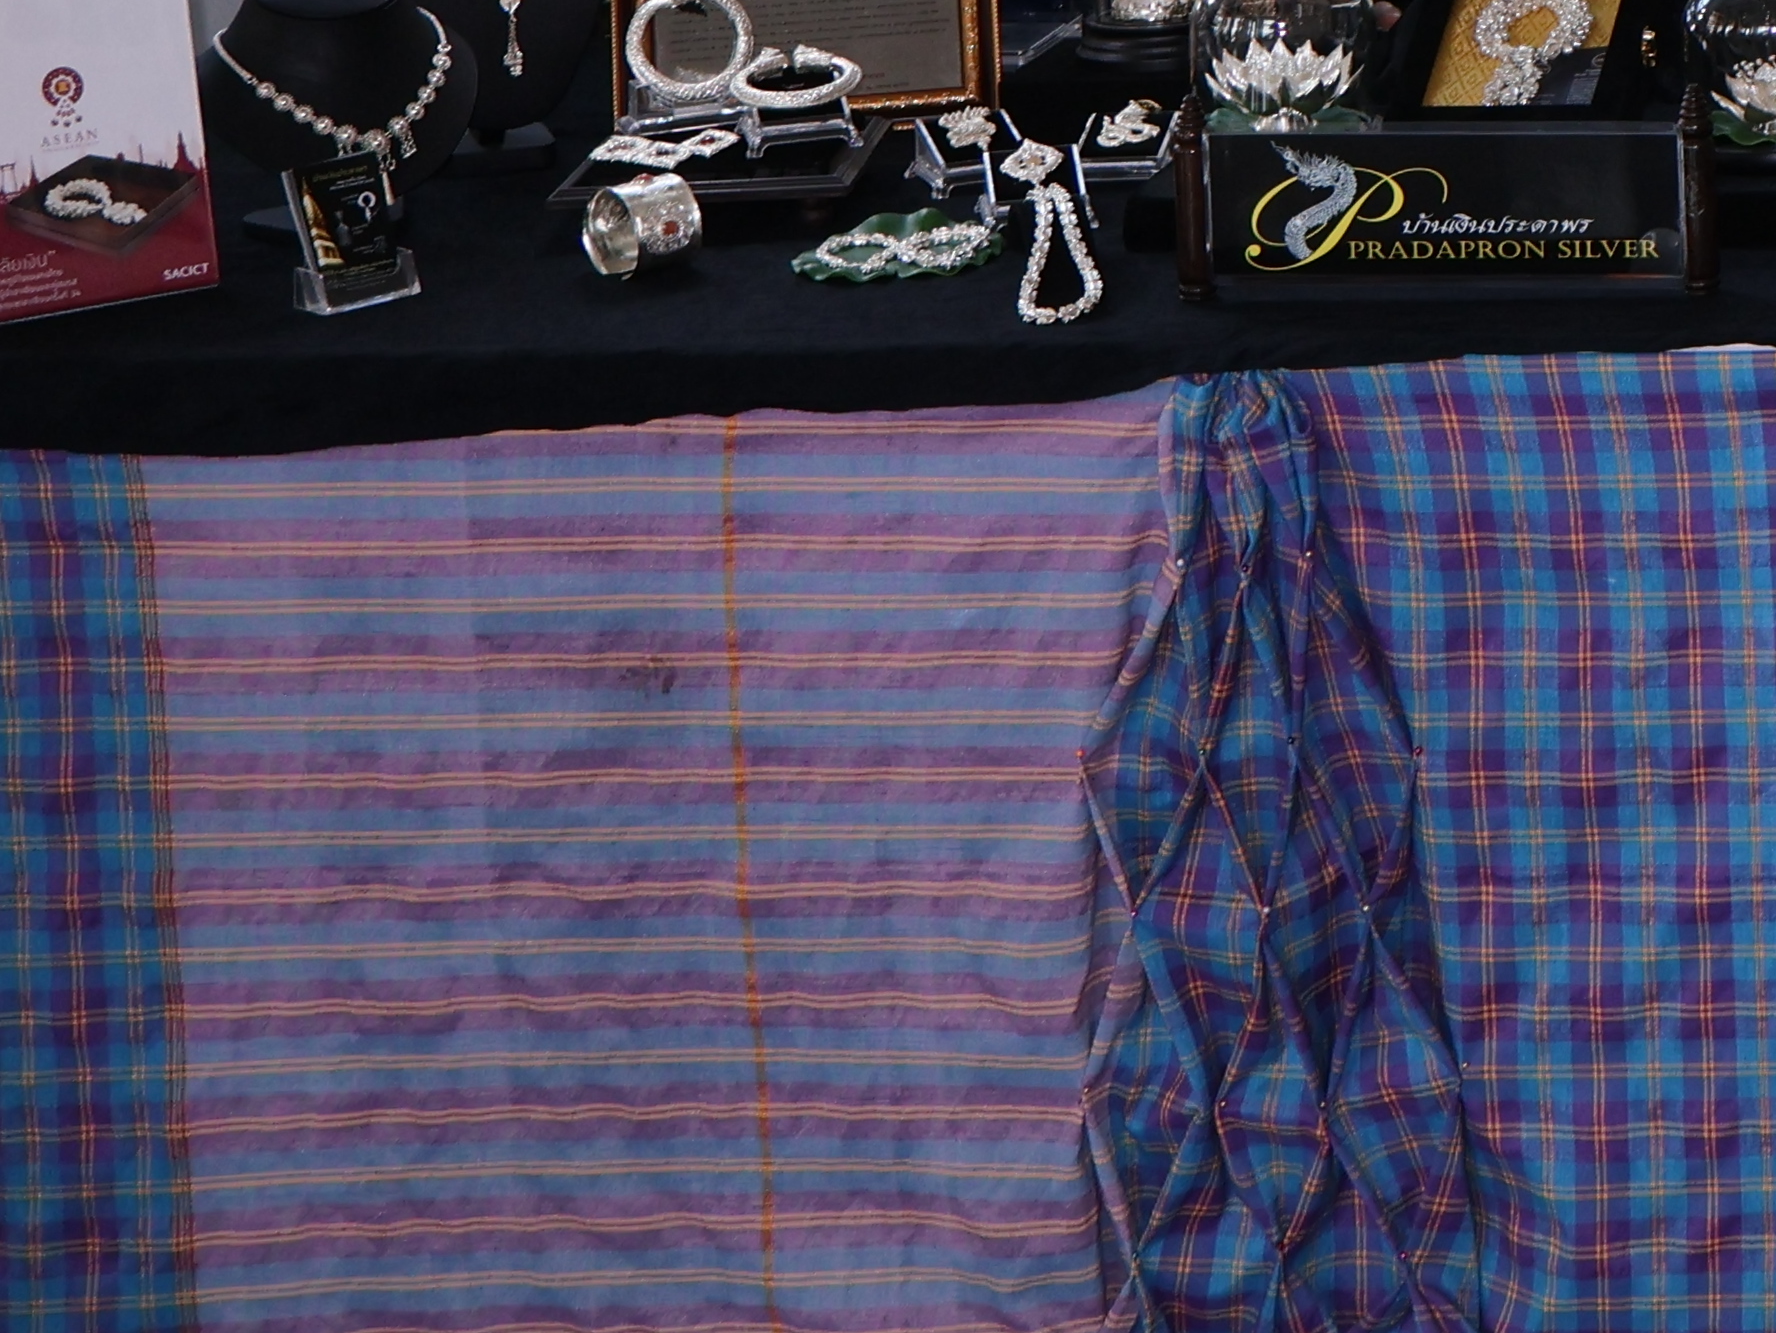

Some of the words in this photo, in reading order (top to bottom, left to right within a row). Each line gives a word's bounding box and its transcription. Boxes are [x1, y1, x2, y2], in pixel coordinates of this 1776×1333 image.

[40, 127, 98, 148] ASEAN
[1402, 213, 1594, 235] บ้านเงินประดาพร
[1348, 240, 1548, 261] PRADAPRON
[1556, 239, 1659, 260] SILVER
[162, 262, 210, 281] SACICT
